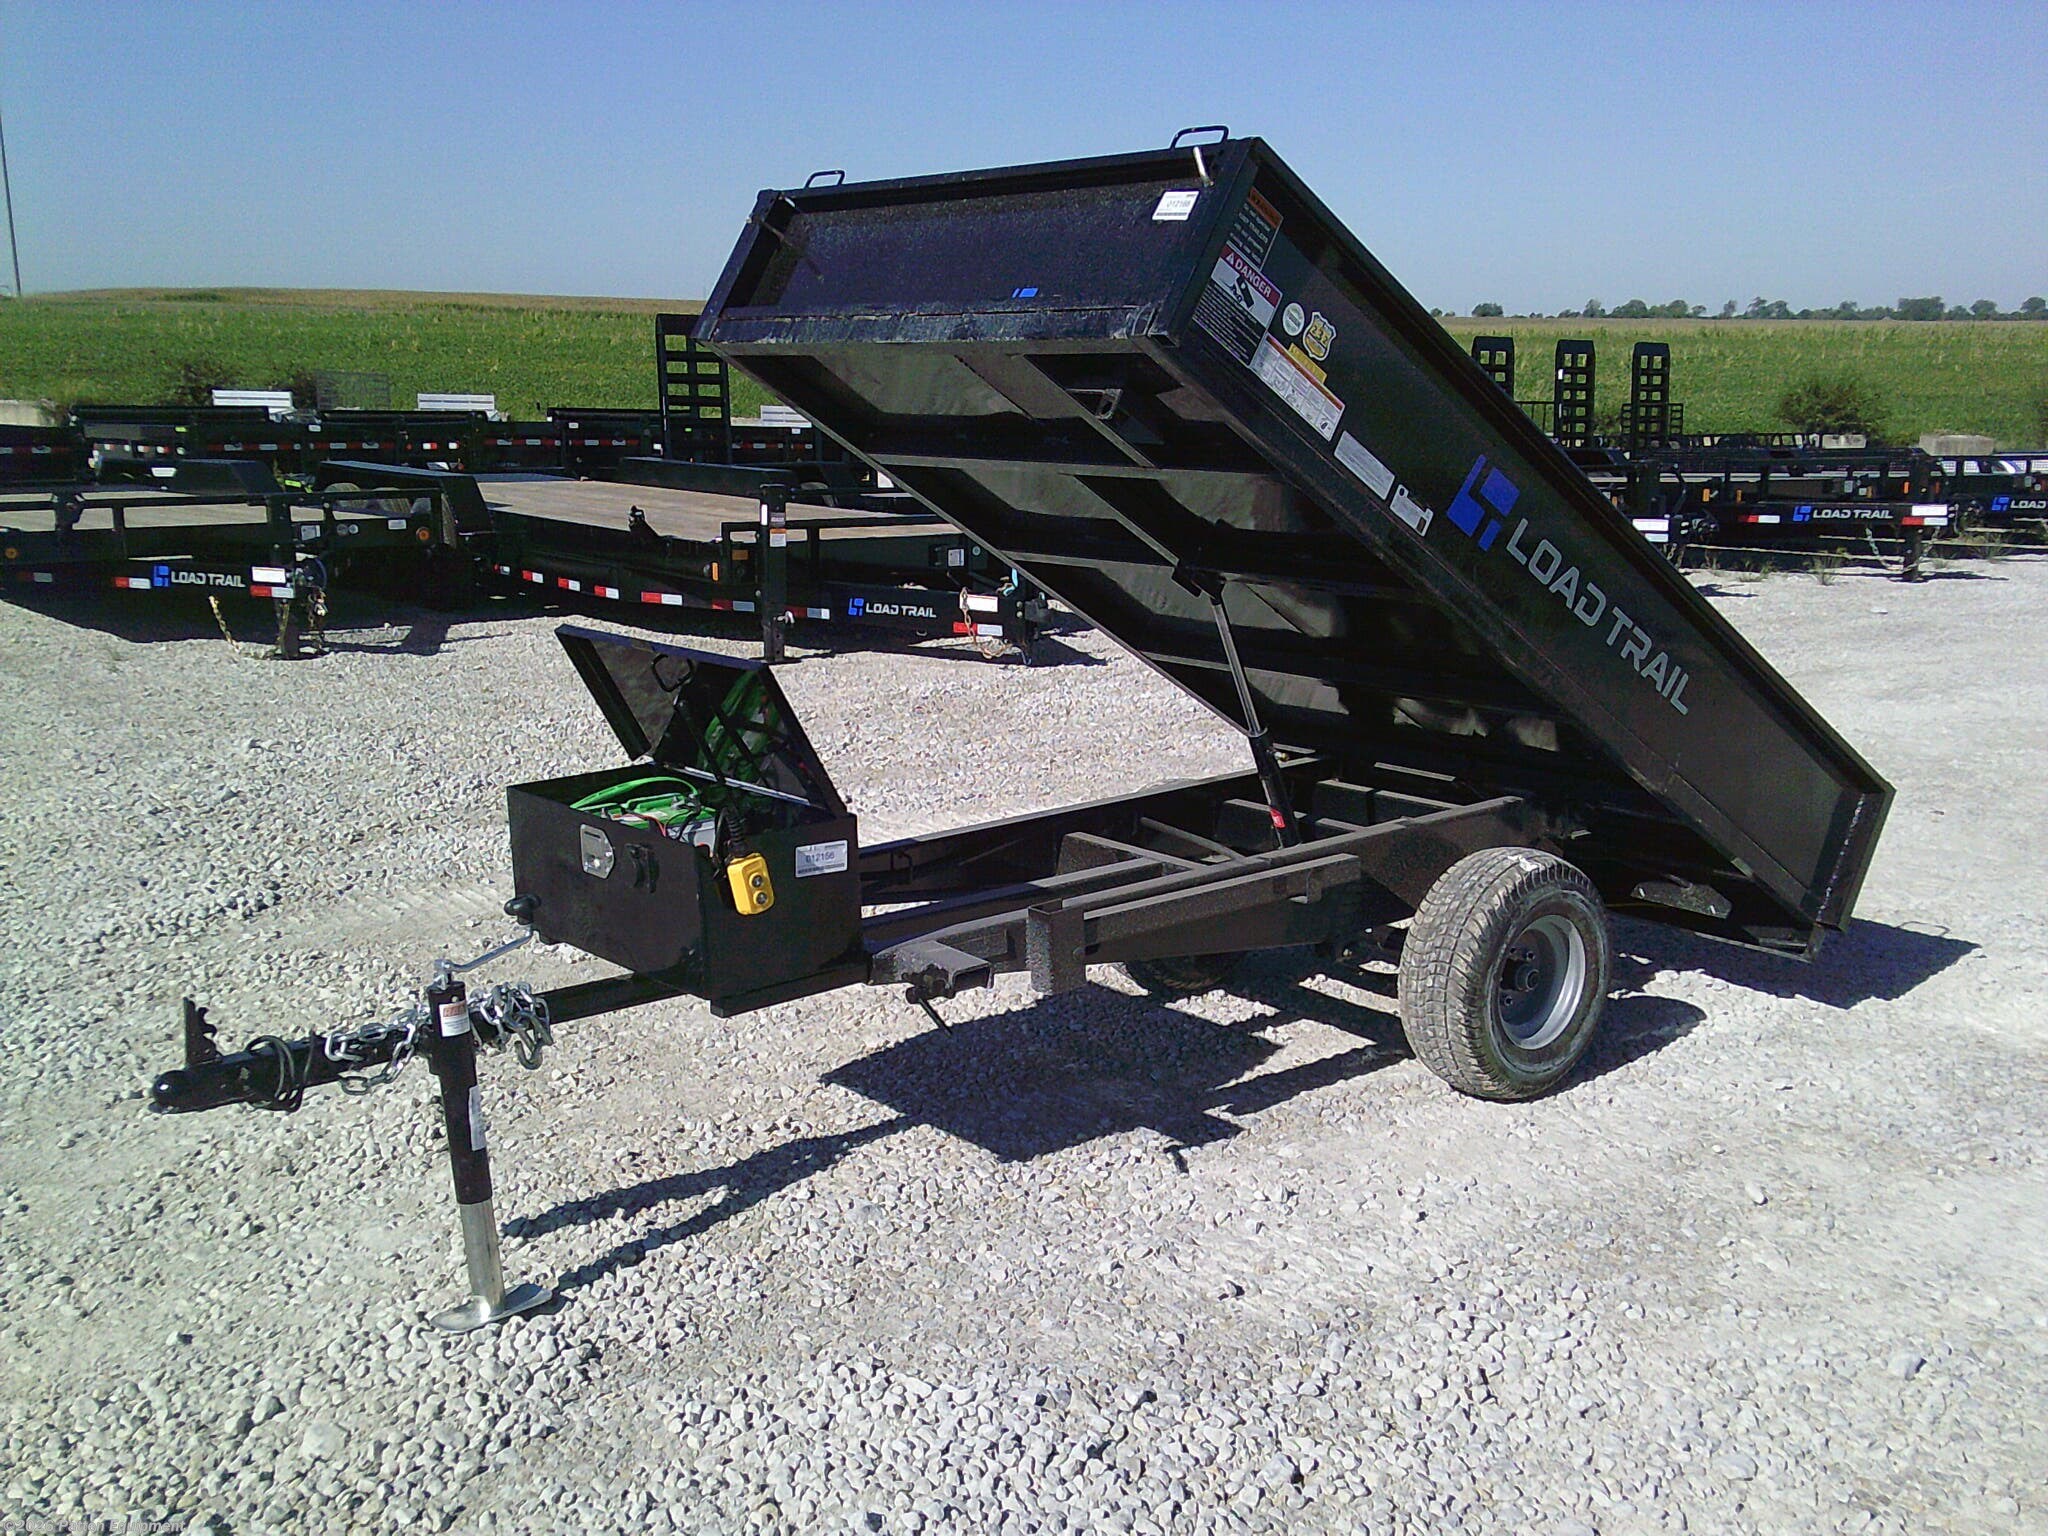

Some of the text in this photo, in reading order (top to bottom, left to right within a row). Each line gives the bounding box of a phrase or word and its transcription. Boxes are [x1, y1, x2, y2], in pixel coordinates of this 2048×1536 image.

[1234, 258, 1272, 298] DANGER
[2010, 500, 2047, 509] LOAD
[1813, 508, 1894, 519] LOAD TRAIL
[171, 571, 246, 588] LOAD TRAIL
[865, 602, 937, 618] LOAD TRAIL
[1506, 517, 1690, 716] LOAD TRAIL
